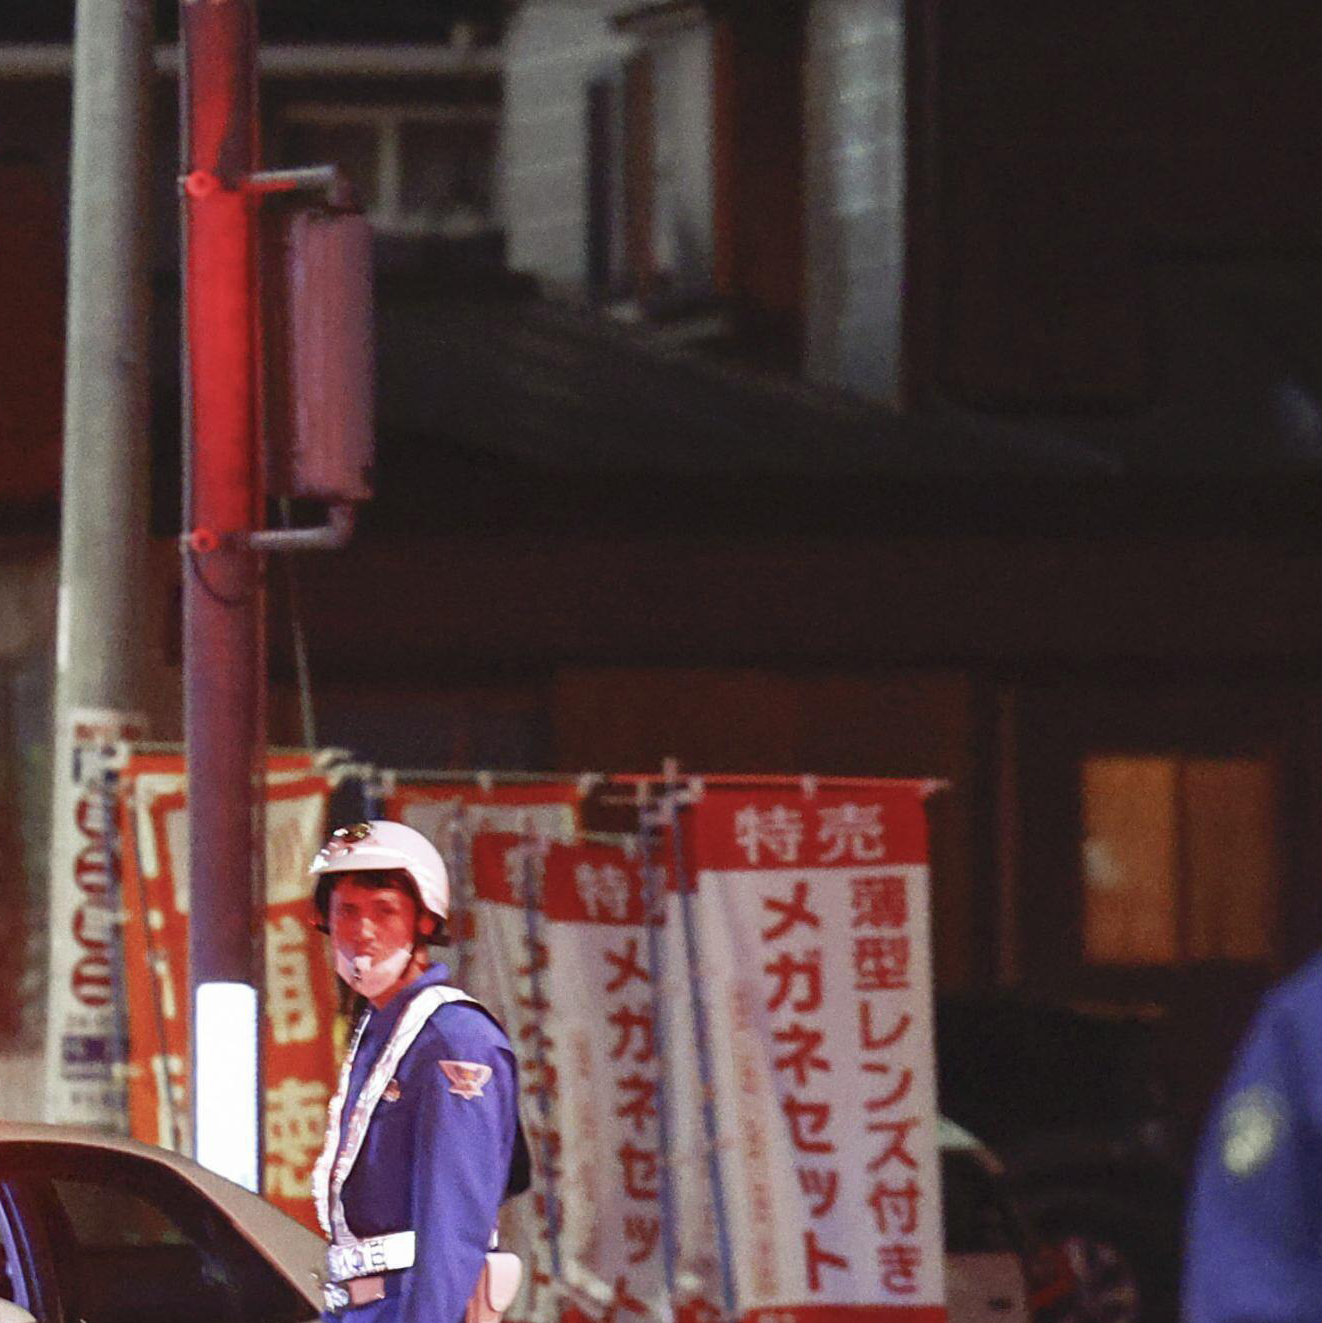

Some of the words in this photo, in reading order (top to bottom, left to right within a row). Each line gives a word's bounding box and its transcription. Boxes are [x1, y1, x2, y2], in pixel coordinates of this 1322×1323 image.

[734, 803, 887, 867] 特売
[761, 880, 849, 1292] メガネセット
